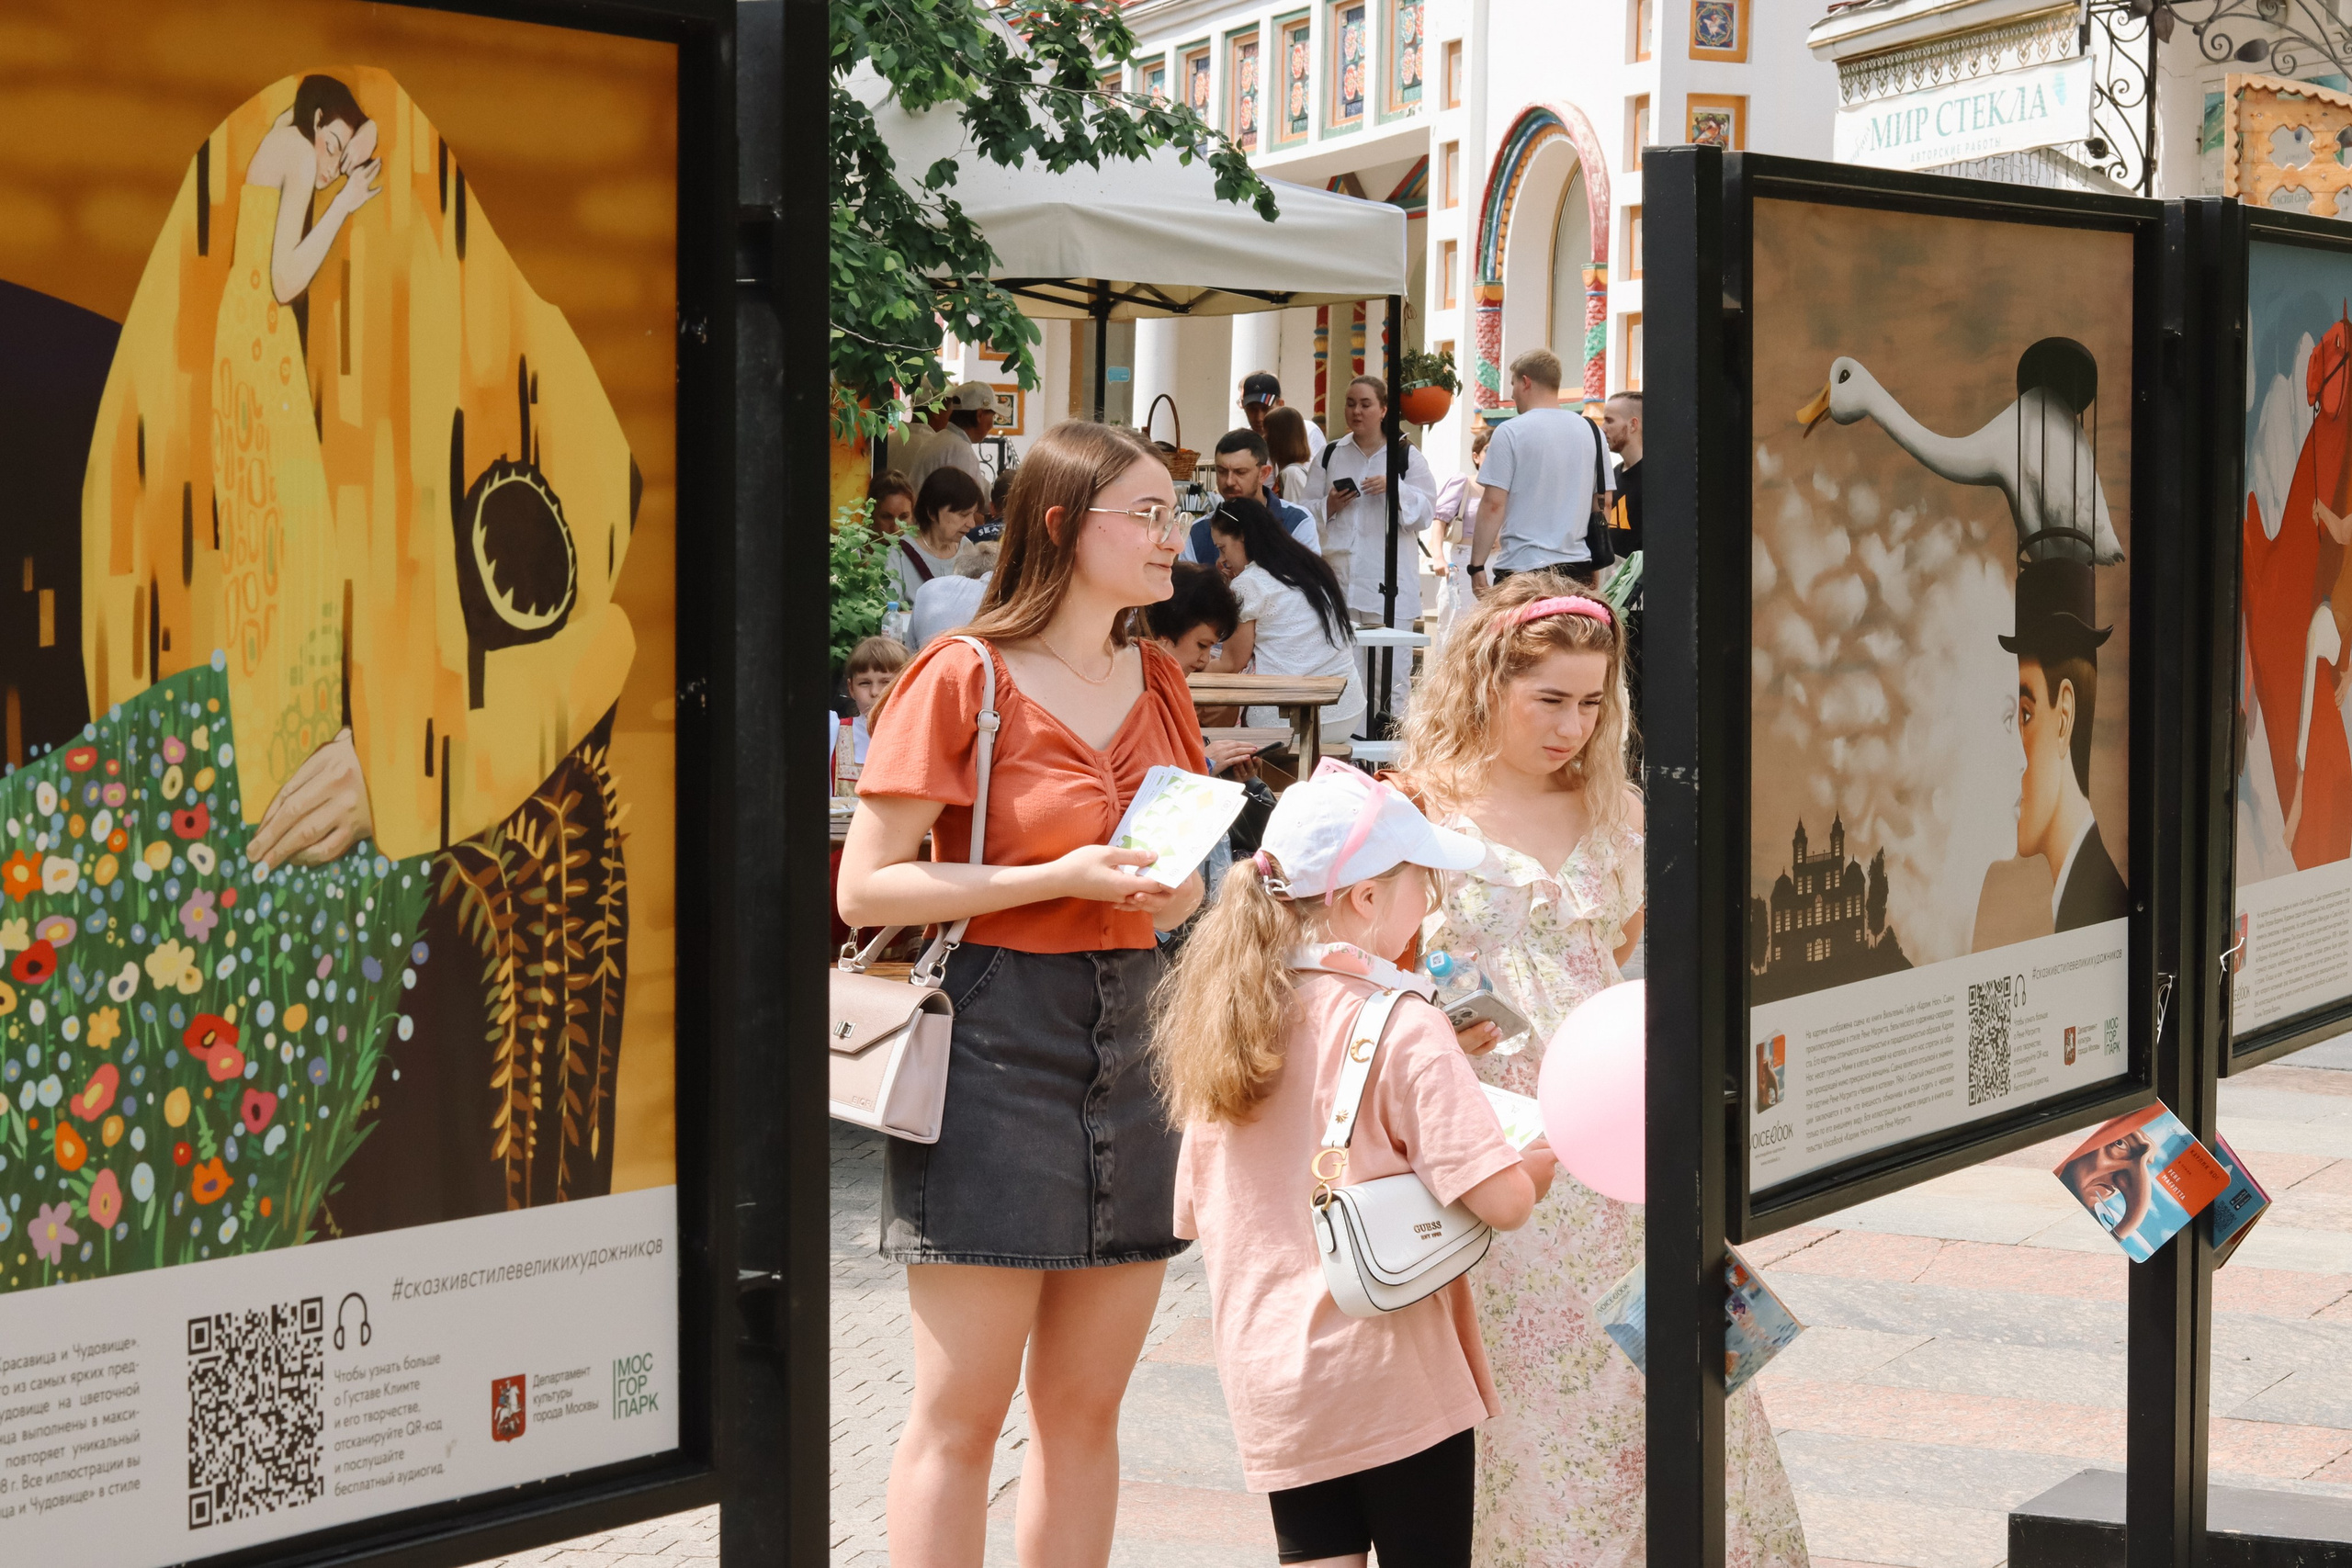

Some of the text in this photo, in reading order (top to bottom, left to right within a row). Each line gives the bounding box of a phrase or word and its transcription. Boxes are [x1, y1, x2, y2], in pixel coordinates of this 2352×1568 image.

[1870, 107, 1928, 152] МИР
[1936, 83, 2048, 137] СТЕКЛА
[1910, 137, 2001, 164] АВТОРСКИЕ РАБОТЫ
[2106, 1017, 2118, 1030] МОС
[2106, 1030, 2116, 1042] ГОР
[2106, 1041, 2120, 1055] ПАРК
[1414, 1221, 1442, 1233] GUESS
[391, 1238, 662, 1300] #сказкивстилевеликихудожников
[61, 1350, 67, 1359] и
[617, 1352, 652, 1377] МОС
[14, 1382, 26, 1393] из
[30, 1375, 65, 1391] самых
[70, 1368, 104, 1385] ярких
[107, 1361, 139, 1379] пред-
[334, 1354, 440, 1382] Чтобы узнать больше
[532, 1367, 590, 1389] Департамент
[58, 1397, 71, 1409] на
[80, 1382, 140, 1406] цветочной
[334, 1381, 420, 1407] о Густаве Климте
[533, 1389, 572, 1406] культуры
[617, 1374, 647, 1398] ГОР
[533, 1401, 598, 1423] города Москвы
[617, 1393, 659, 1418] ПАРК
[22, 1419, 86, 1440] выполнены
[102, 1410, 139, 1424] макси-
[334, 1419, 340, 1428] и
[343, 1415, 360, 1427] его
[334, 1419, 442, 1451] отсканируйте QR-код
[6, 1428, 140, 1468] повторяет уникальный
[22, 1473, 42, 1490] Все
[46, 1459, 123, 1483] иллюстрации
[127, 1456, 140, 1468] вы
[334, 1450, 404, 1473] и послушайте
[18, 1504, 26, 1513] и
[108, 1479, 140, 1495] стиле
[334, 1472, 394, 1496] бесплатный
